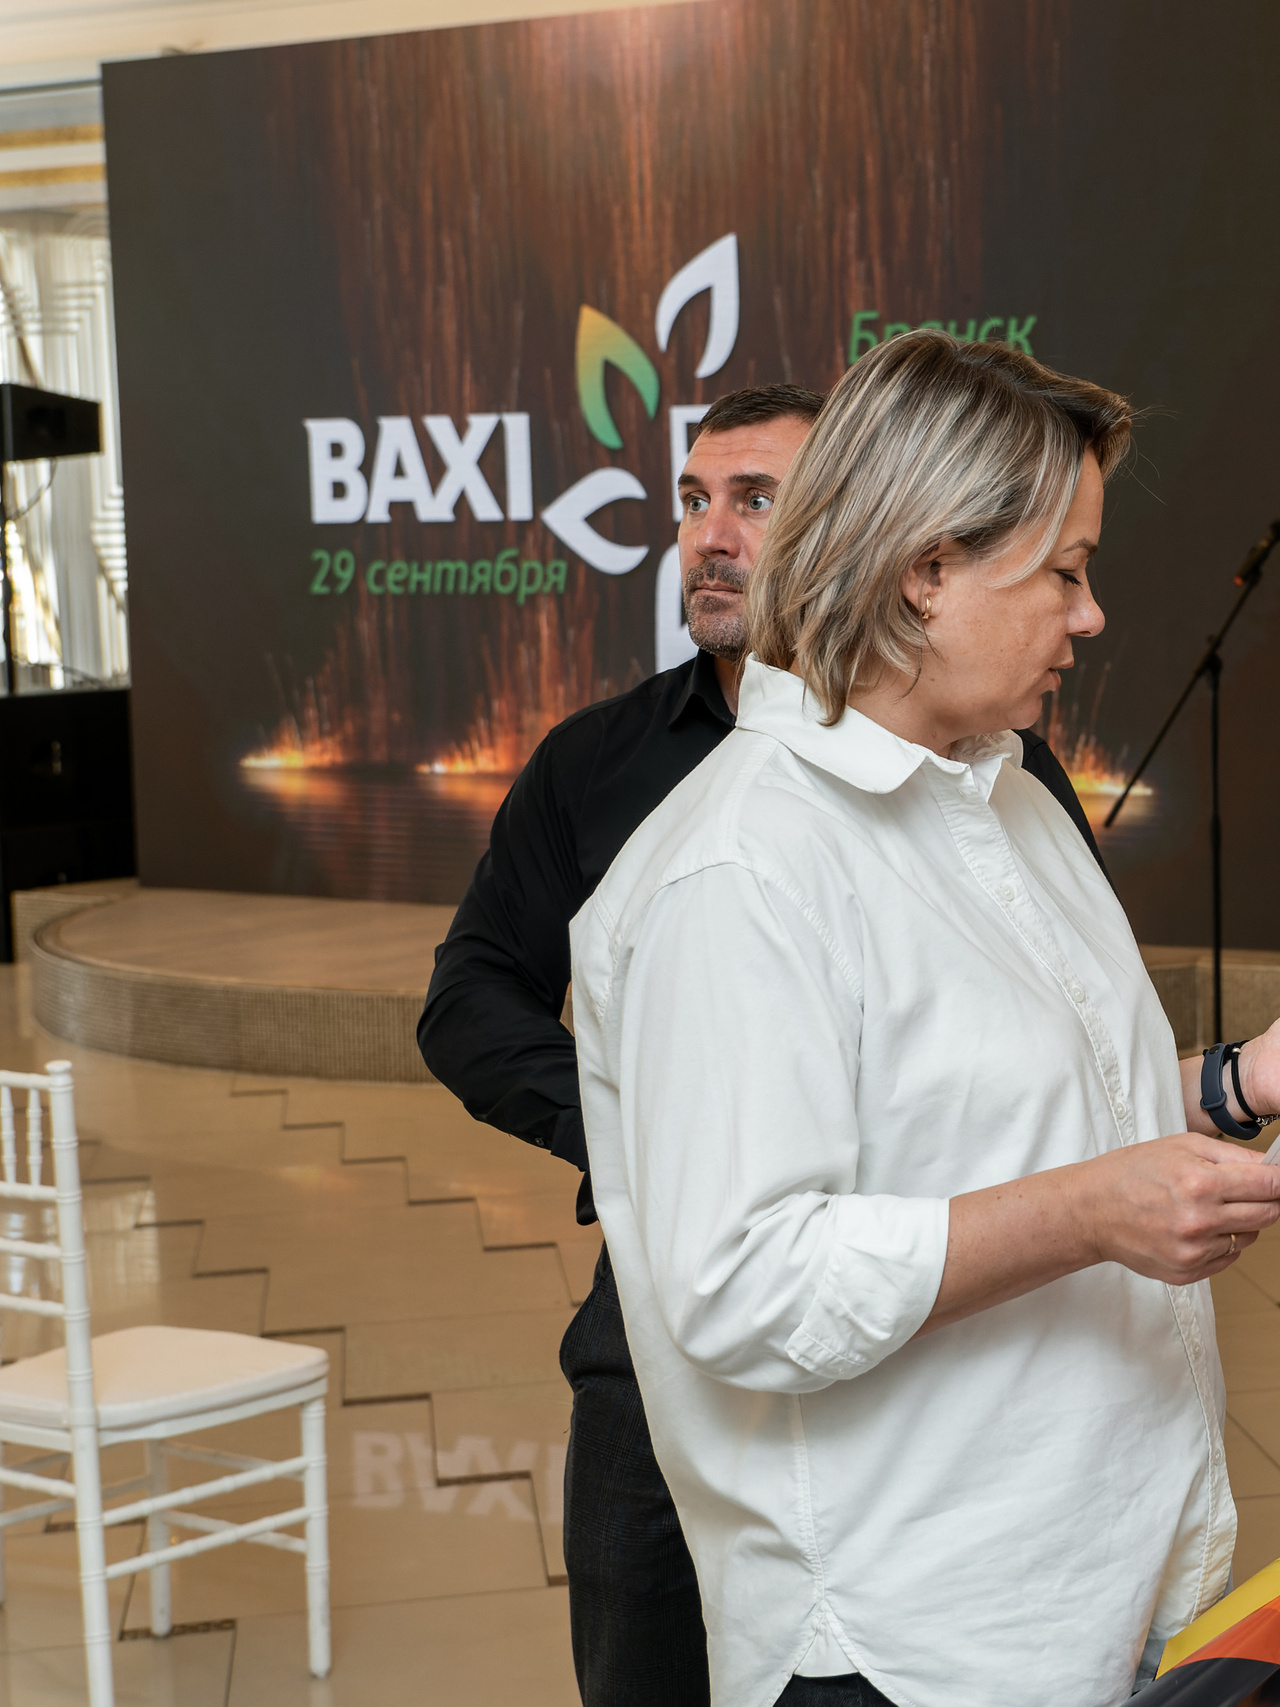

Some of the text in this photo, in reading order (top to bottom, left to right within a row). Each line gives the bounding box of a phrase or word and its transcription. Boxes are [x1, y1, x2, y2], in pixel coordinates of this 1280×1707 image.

[304, 411, 534, 524] BAXI
[310, 549, 569, 603] 29 сентября
